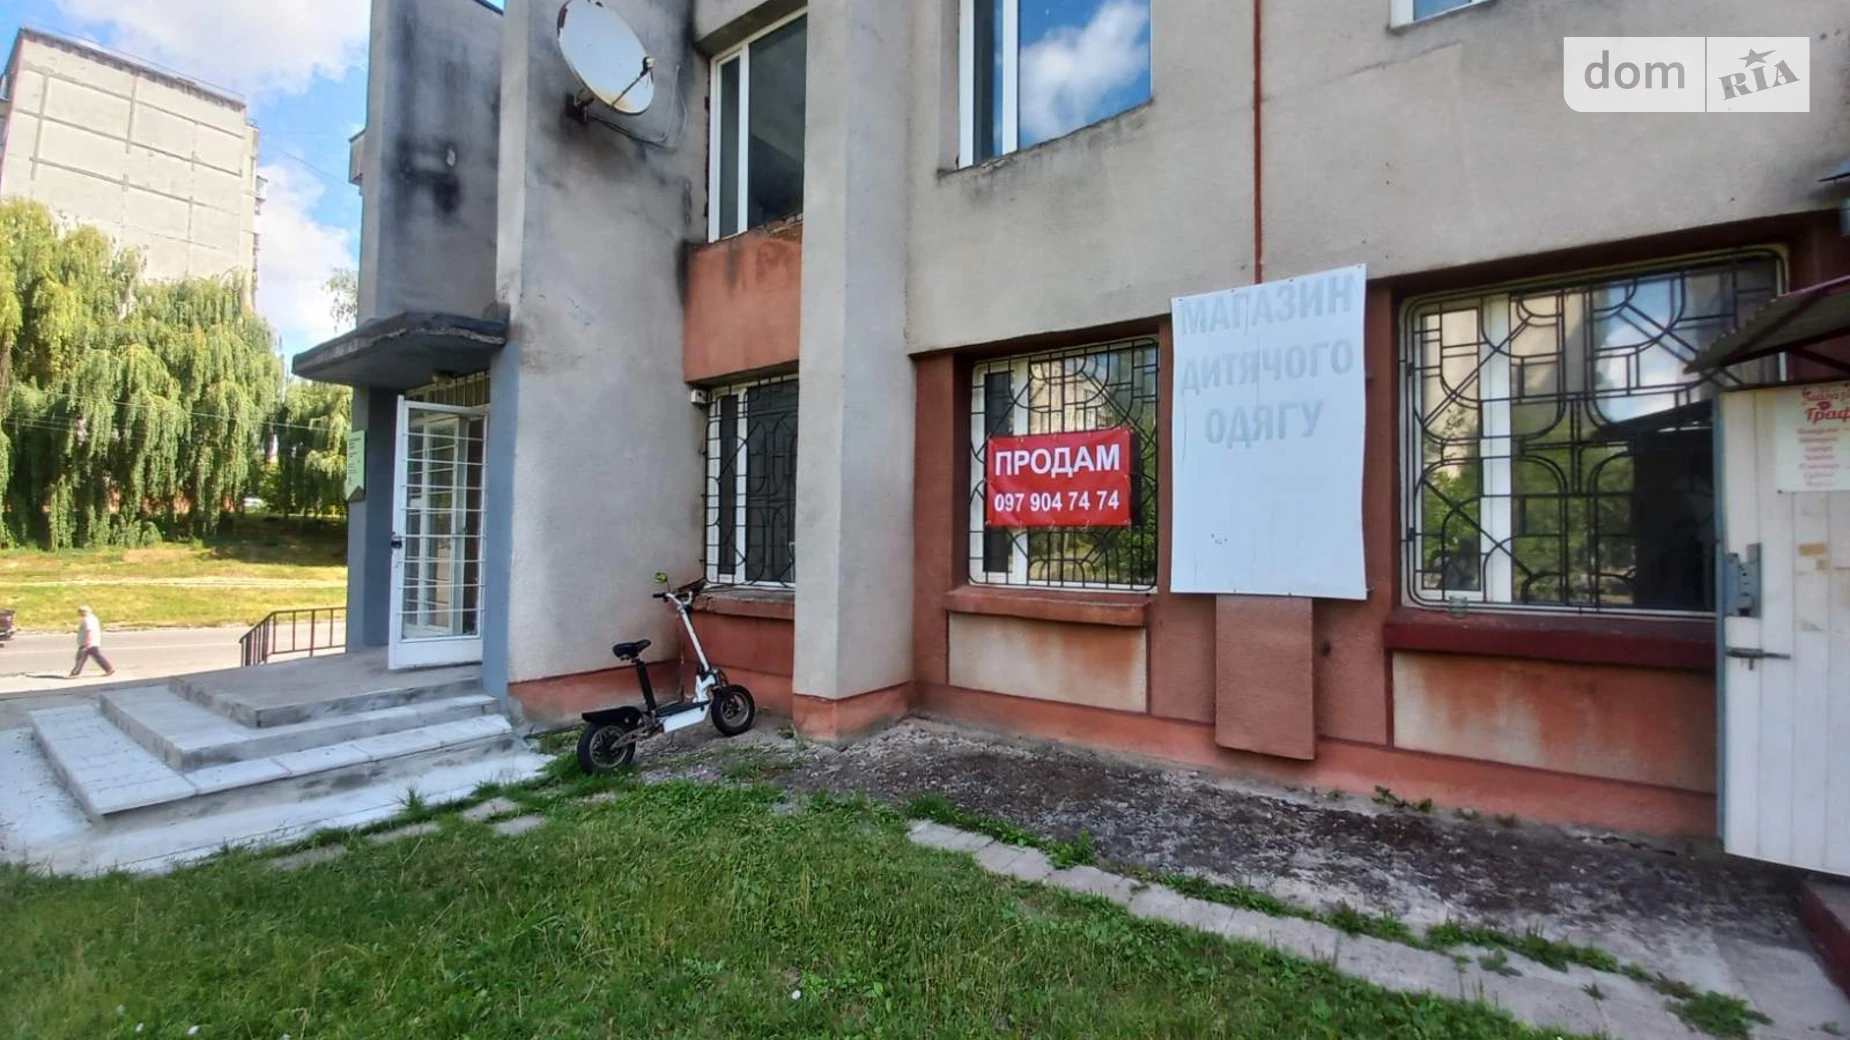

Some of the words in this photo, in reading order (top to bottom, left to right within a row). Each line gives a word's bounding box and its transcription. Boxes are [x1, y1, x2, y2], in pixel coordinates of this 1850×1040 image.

[1181, 339, 1353, 396] ДИТЯЧОГО
[1204, 400, 1324, 449] ОДЯГУ
[994, 443, 1121, 478] ПРОДАМ
[994, 493, 1024, 512] 097
[1030, 492, 1063, 512] 904
[1067, 491, 1091, 511] 74
[1096, 490, 1120, 511] 74
